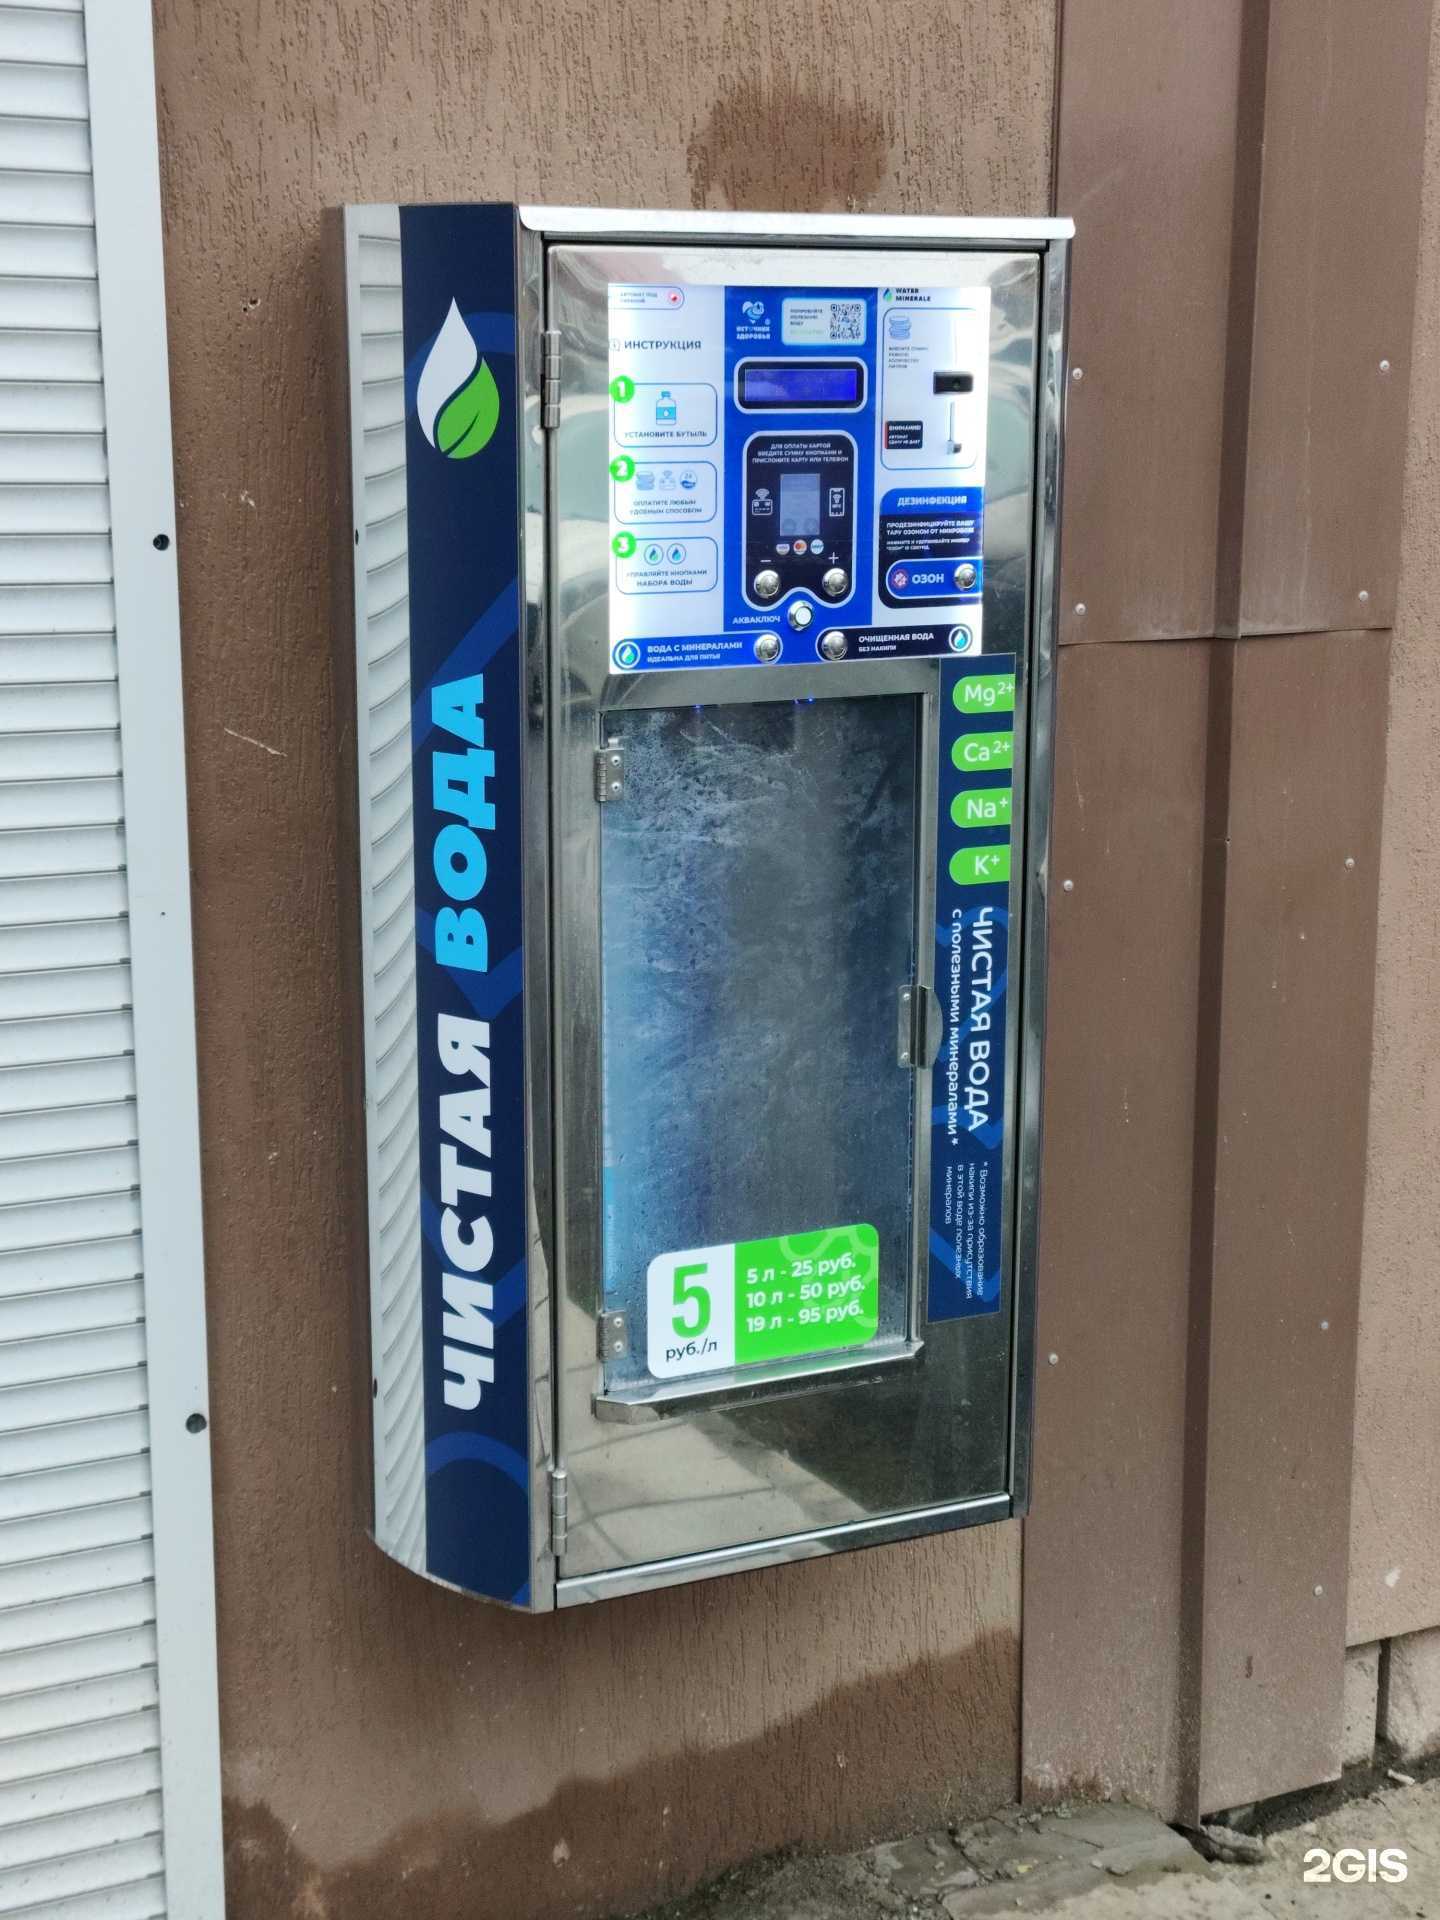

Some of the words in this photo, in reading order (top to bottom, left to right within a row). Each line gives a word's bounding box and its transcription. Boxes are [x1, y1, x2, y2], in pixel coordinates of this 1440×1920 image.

[625, 340, 702, 350] ИНСТРУКЦИЯ
[676, 430, 707, 438] БУТЫЛЬ
[897, 495, 968, 507] ДЕЗИНФЕКЦИЯ
[637, 579, 668, 587] НАБОРА
[912, 573, 945, 584] ОЗОН
[732, 615, 781, 625] АКВАКЛЮЧ
[647, 645, 673, 654] ВОДА
[674, 644, 680, 652] С
[681, 642, 743, 651] МИНЕРАЛАМИ
[858, 634, 910, 643] ОЧИЩЕННАЯ
[911, 632, 934, 641] ВОДА
[647, 655, 684, 663] ИДЕАЛЬНА
[684, 654, 699, 662] ДЛЯ
[431, 673, 496, 972] ВОДА
[952, 908, 962, 919] с
[949, 924, 962, 1023] полезными
[970, 907, 993, 1032] ЧИСТАЯ
[964, 1040, 991, 1132] ВОДА
[944, 1166, 953, 1225] минералов
[957, 1173, 965, 1199] этой
[979, 1169, 988, 1226] Возможно
[437, 1012, 495, 1411] ЧИСТАЯ
[955, 1200, 963, 1226] воде
[967, 1203, 975, 1231] из-за
[746, 1268, 758, 1284] 5
[762, 1268, 775, 1282] л
[791, 1260, 813, 1278] 25
[817, 1252, 856, 1276] руб.
[954, 1228, 963, 1279] полезных
[965, 1233, 974, 1299] присутствия
[977, 1227, 986, 1296] образование
[671, 1262, 711, 1339] 5
[746, 1292, 766, 1309] 10
[770, 1291, 783, 1305] л
[800, 1282, 822, 1300] 50
[827, 1275, 865, 1299] руб.
[746, 1315, 765, 1333] 19
[769, 1315, 783, 1329] л
[798, 1306, 821, 1325] 95
[826, 1299, 864, 1324] руб.
[665, 1338, 718, 1362] руб./л
